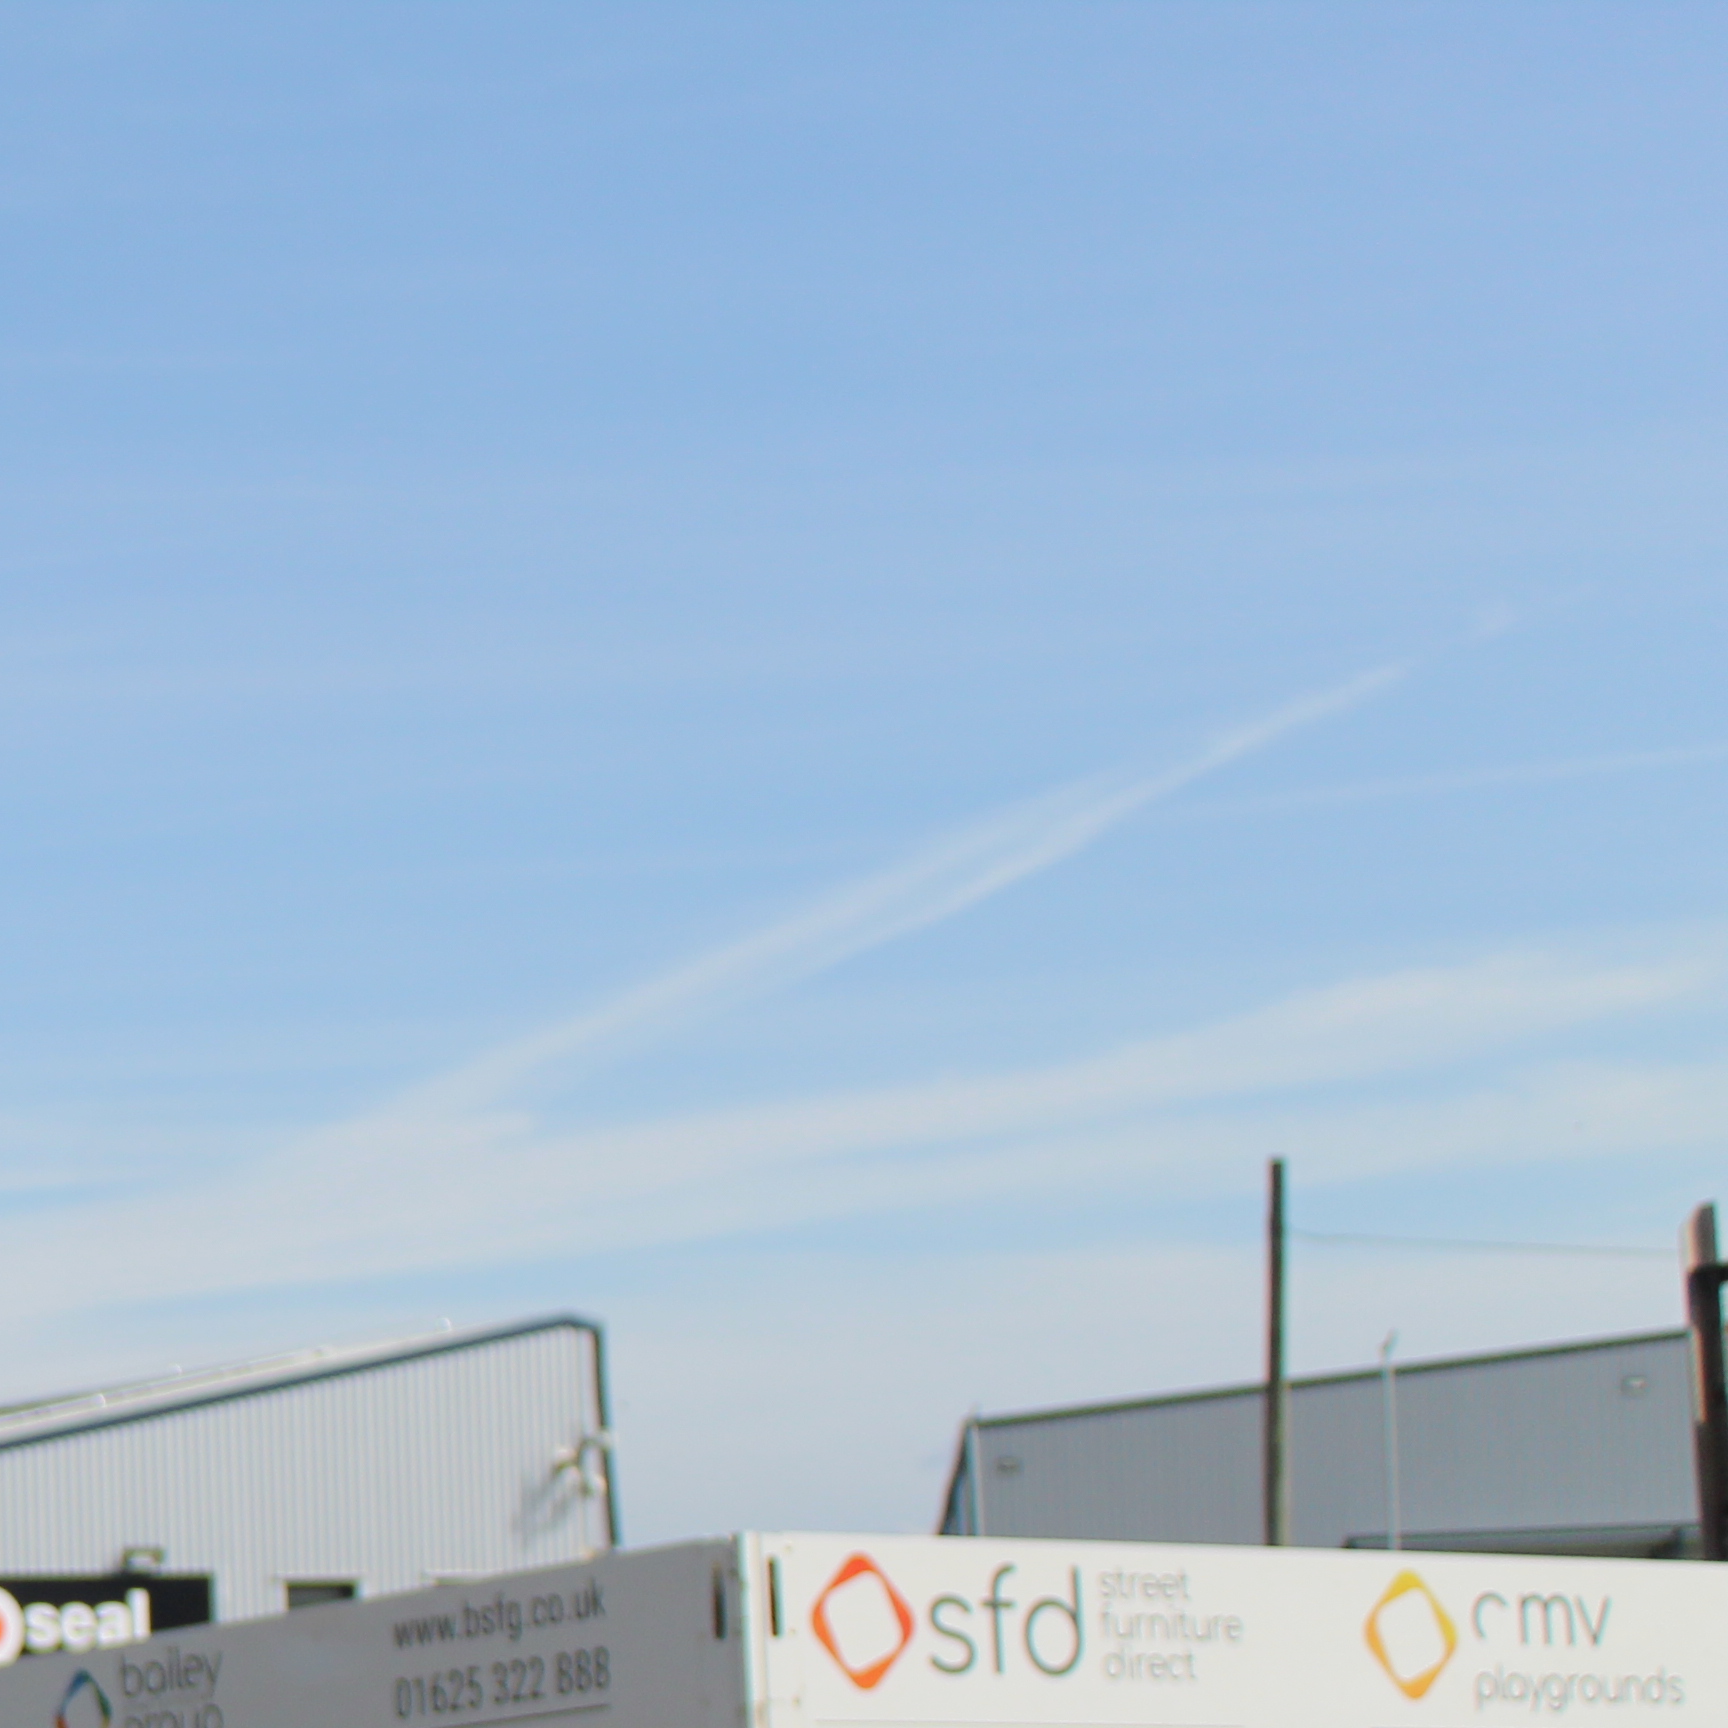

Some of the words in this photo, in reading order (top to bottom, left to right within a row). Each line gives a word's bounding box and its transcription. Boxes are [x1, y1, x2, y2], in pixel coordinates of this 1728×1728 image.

[1099, 1564, 1191, 1601] street
[393, 1577, 607, 1648] www.bsfg.co.uk
[928, 1560, 1085, 1677] sfd
[1100, 1603, 1245, 1643] furniture
[120, 1646, 223, 1698] bailey
[394, 1664, 484, 1719] 01625
[491, 1655, 546, 1705] 322
[555, 1645, 612, 1695] 888
[1104, 1646, 1197, 1682] direct
[1473, 1665, 1687, 1714] playgrounds
